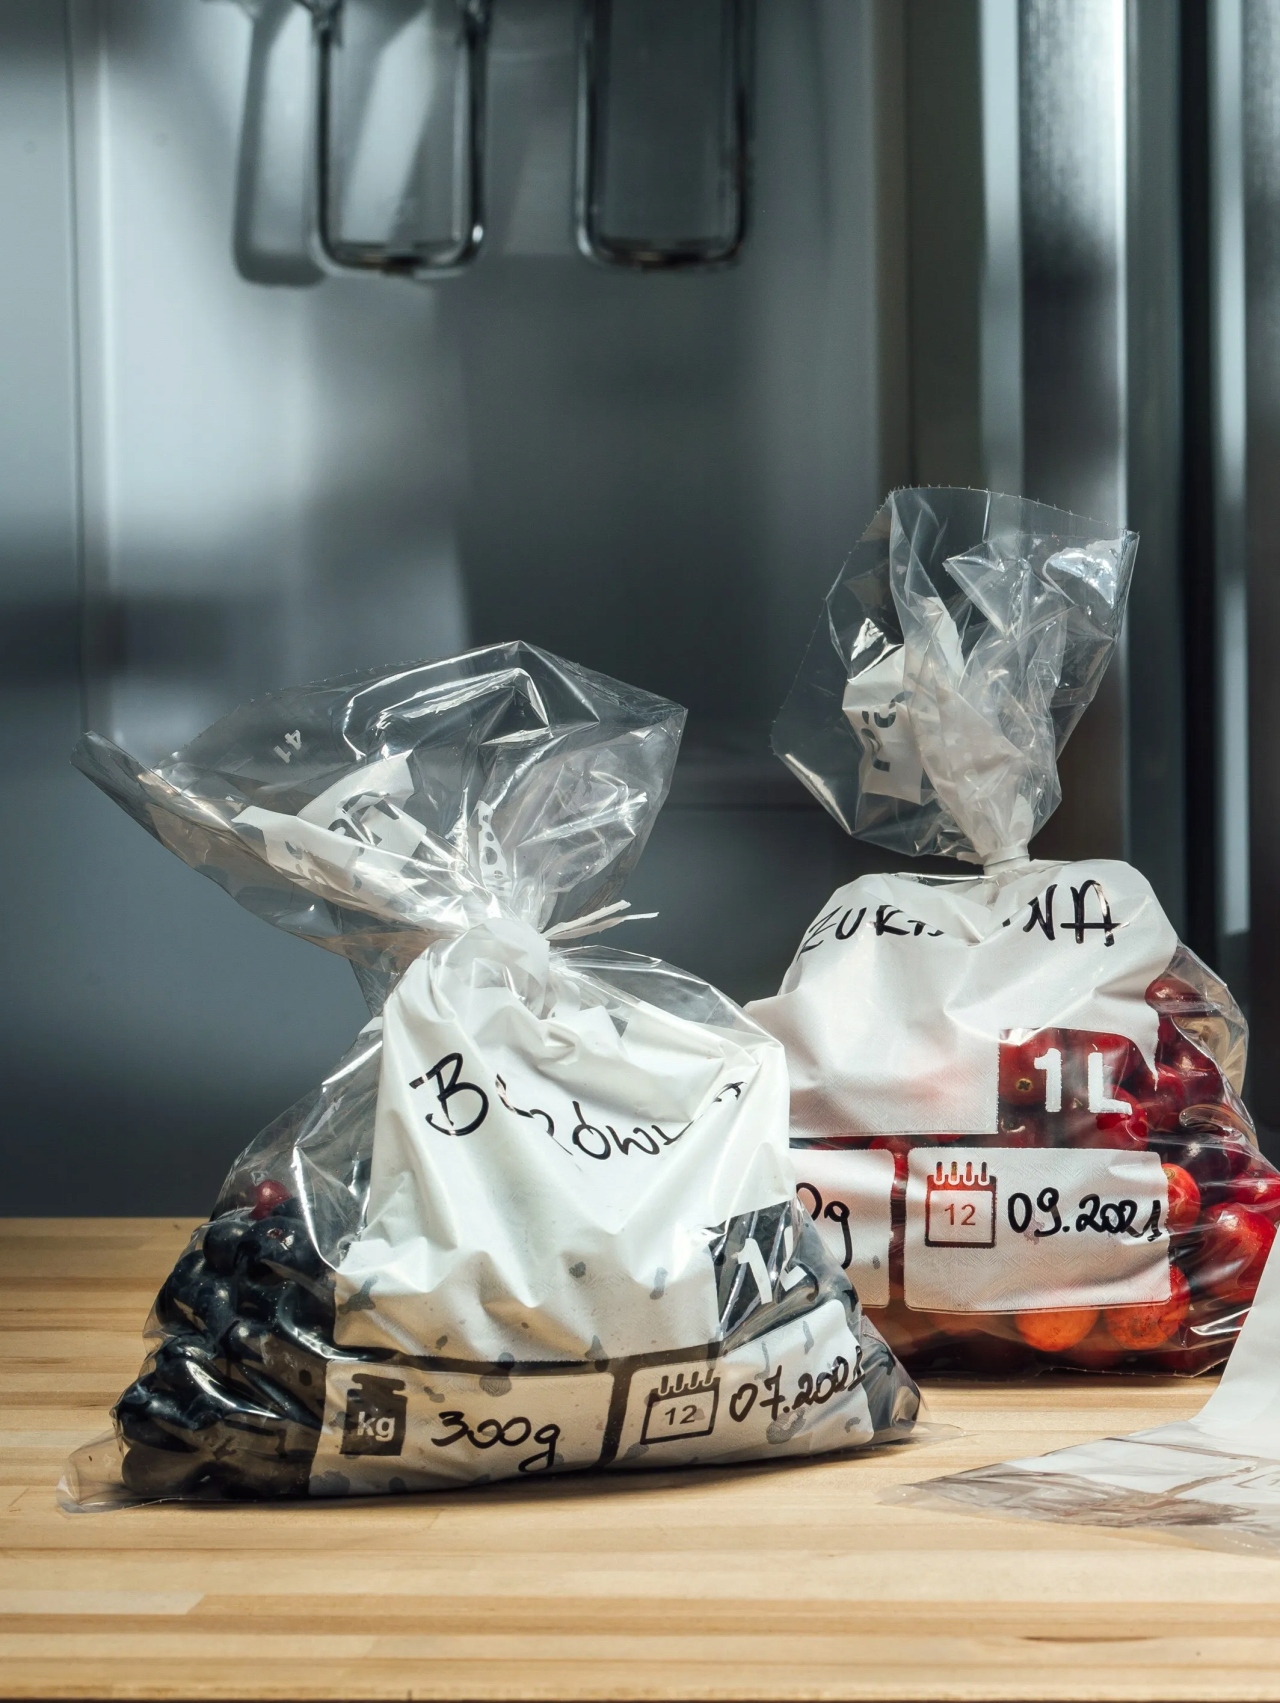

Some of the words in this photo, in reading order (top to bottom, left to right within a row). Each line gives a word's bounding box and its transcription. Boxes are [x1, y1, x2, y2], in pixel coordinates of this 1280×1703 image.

[944, 1202, 977, 1227] 12
[1007, 1186, 1163, 1243] 09.2021
[356, 1410, 396, 1442] kg
[664, 1404, 697, 1427] 12
[431, 1410, 562, 1472] 300g
